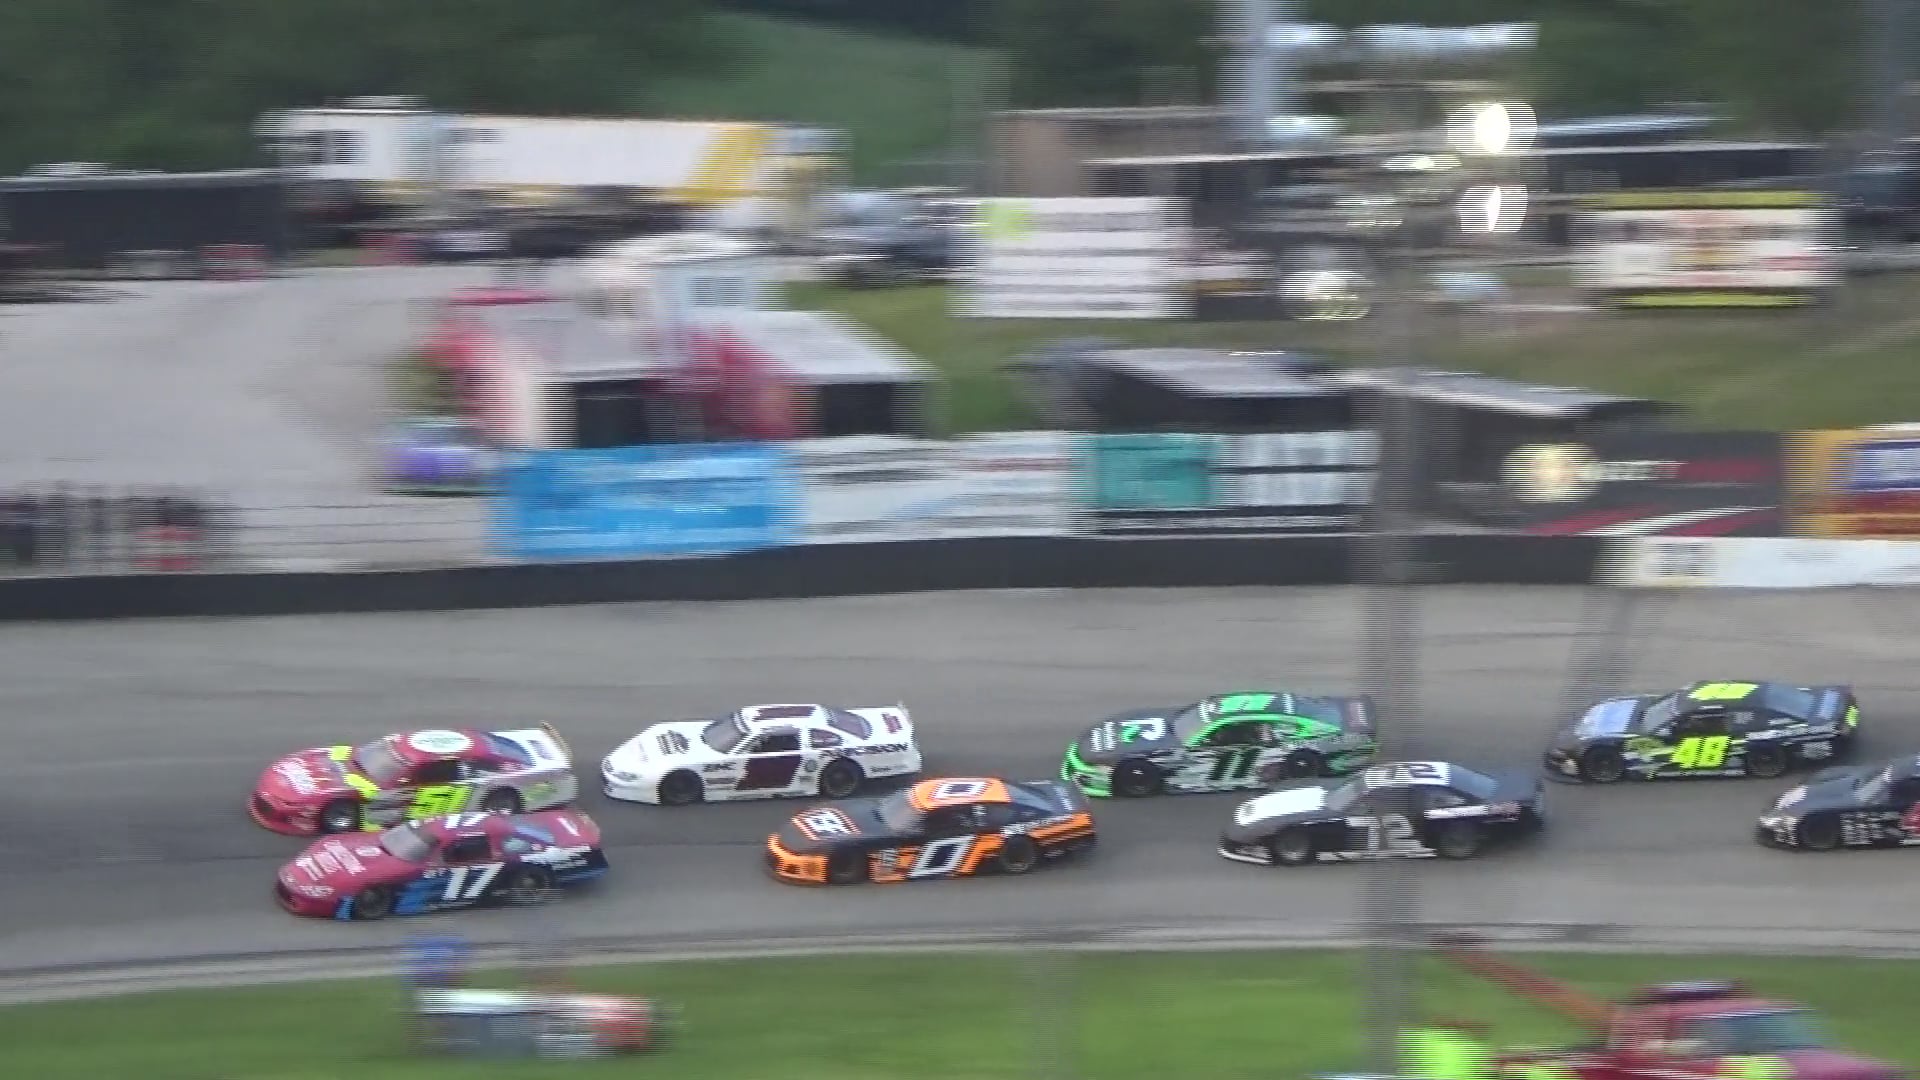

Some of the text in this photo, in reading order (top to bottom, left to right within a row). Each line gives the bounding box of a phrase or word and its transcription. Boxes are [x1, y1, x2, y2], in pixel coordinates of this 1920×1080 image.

[1671, 736, 1731, 769] 48
[408, 785, 472, 820] 51
[907, 834, 978, 879] 0
[441, 861, 505, 901] 17
